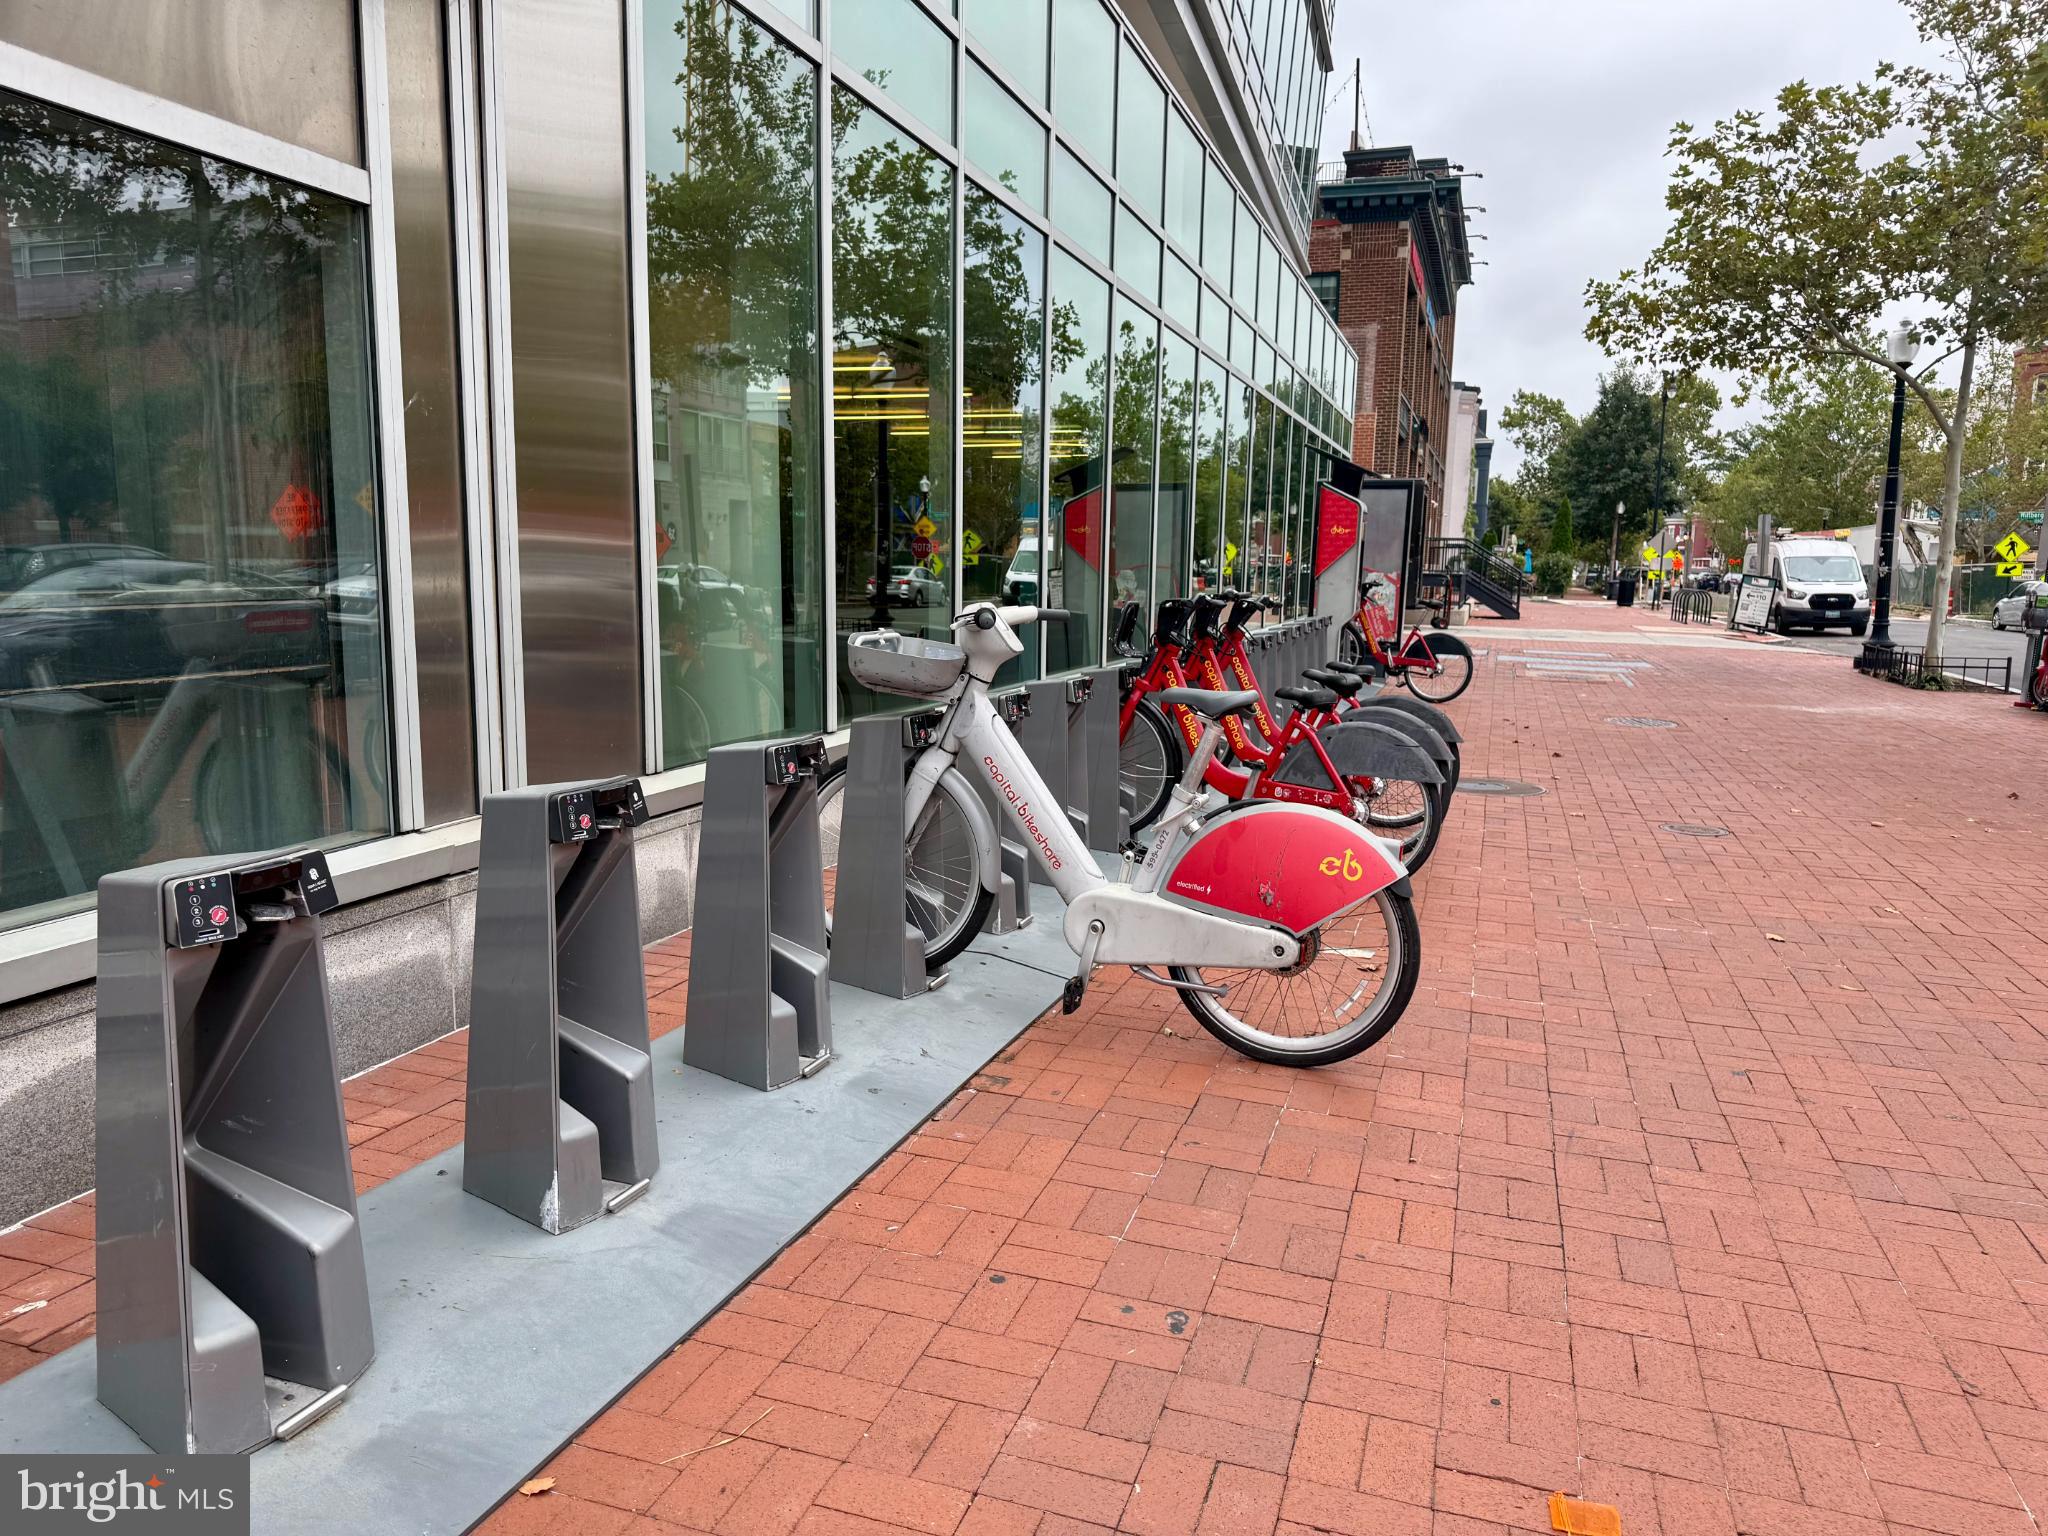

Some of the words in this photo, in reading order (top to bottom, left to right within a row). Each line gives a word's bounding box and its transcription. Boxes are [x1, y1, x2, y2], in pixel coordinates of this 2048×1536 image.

[1233, 656, 1253, 690] capital
[984, 756, 1020, 804] capital
[1017, 802, 1061, 869] bikeshare
[1176, 880, 1205, 892] electrified
